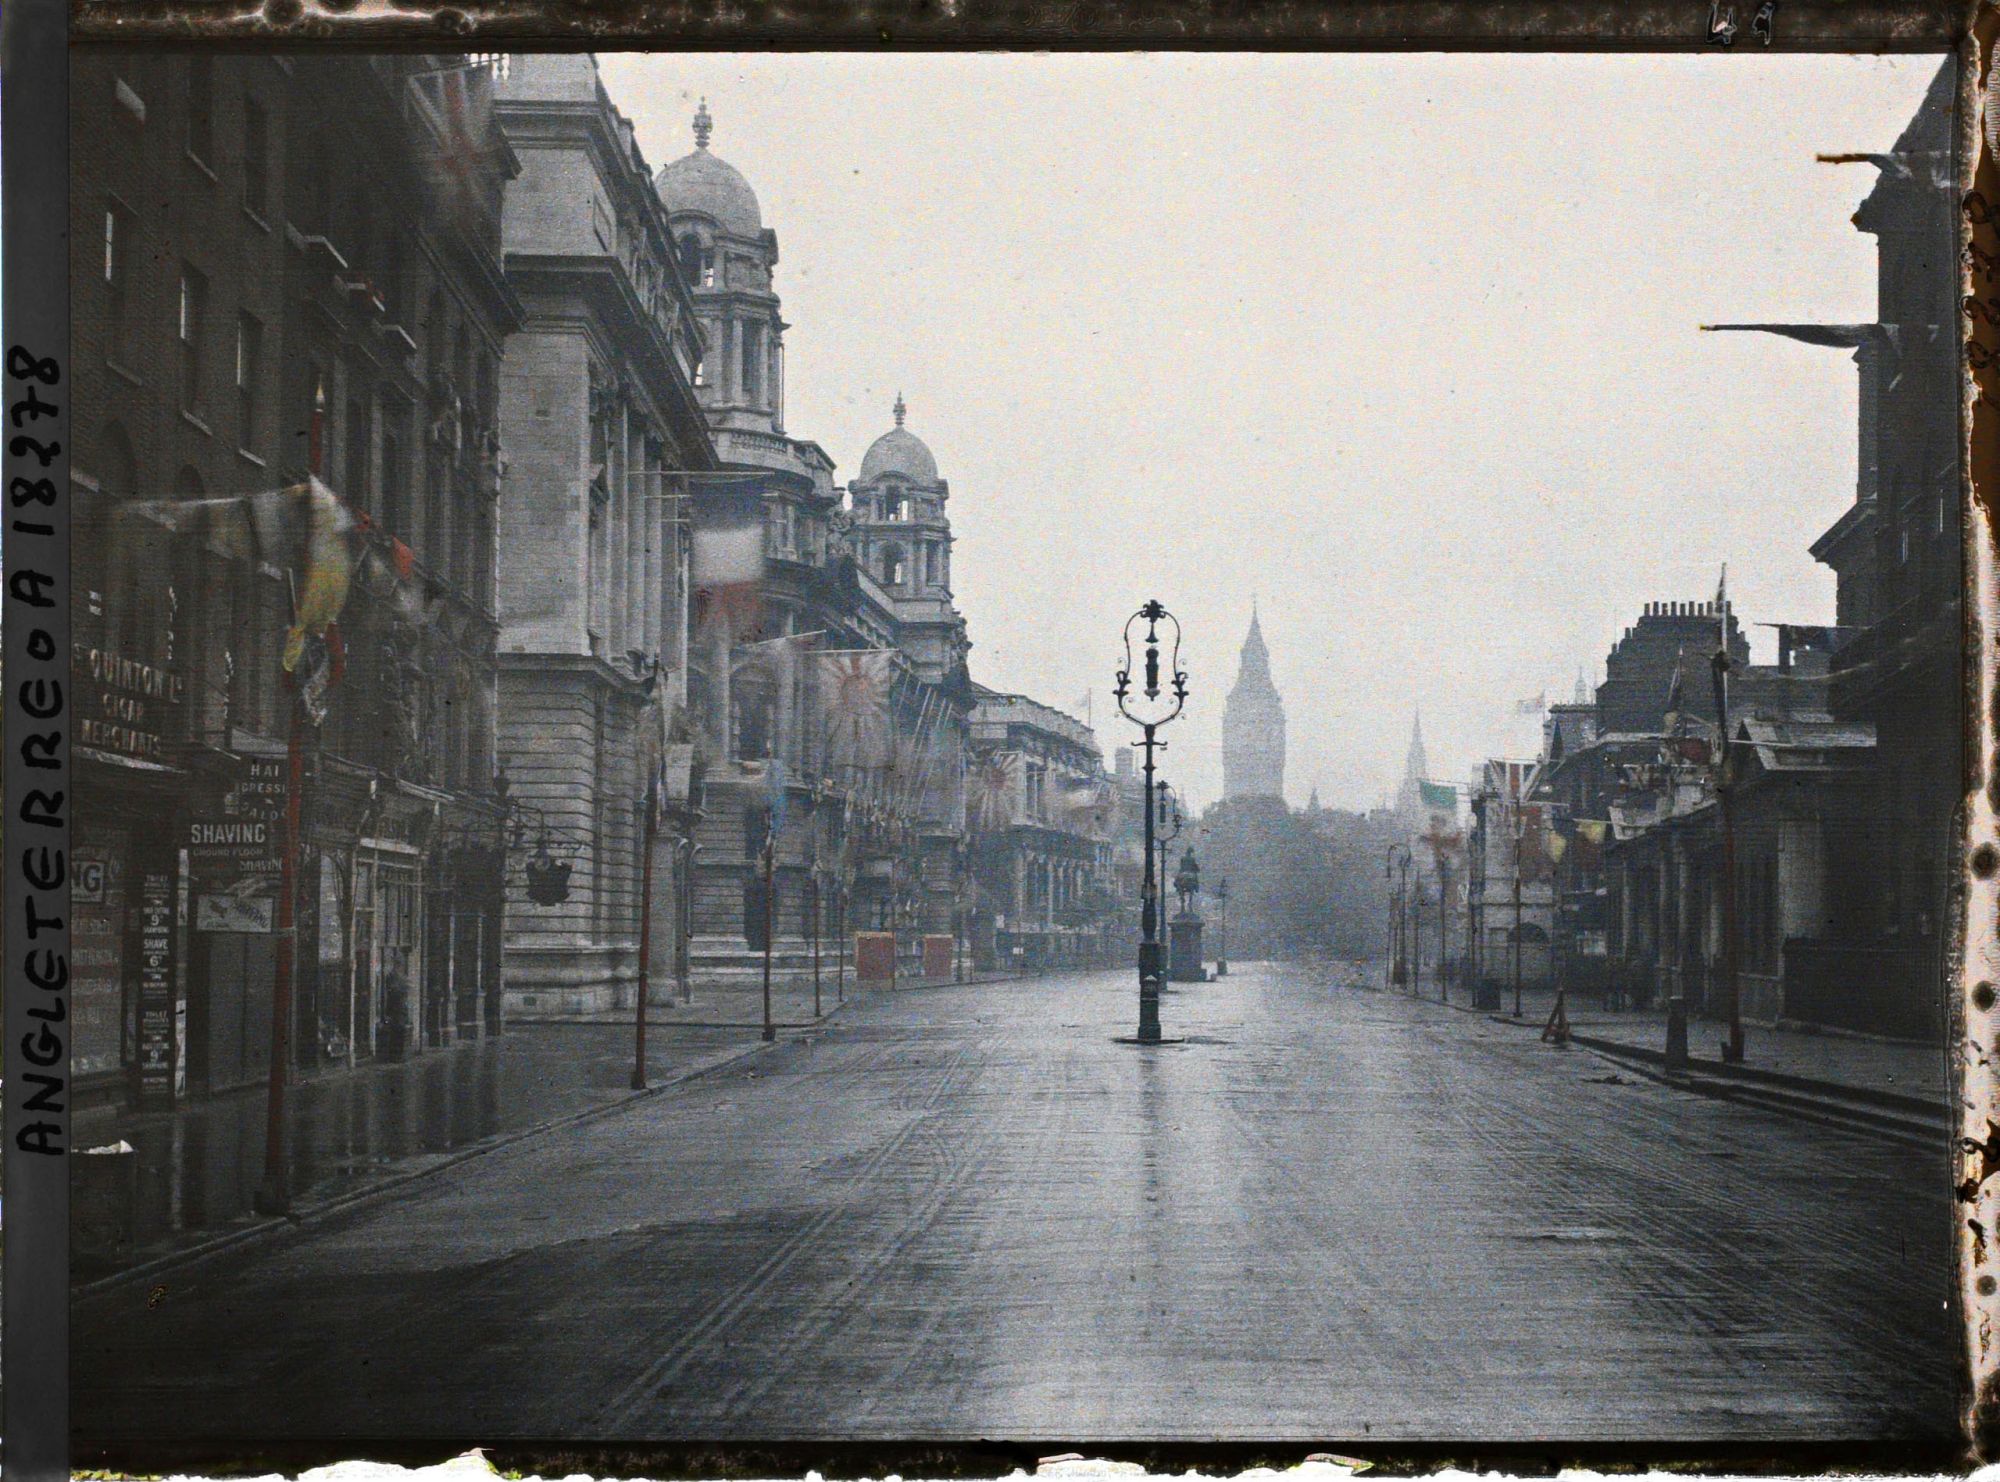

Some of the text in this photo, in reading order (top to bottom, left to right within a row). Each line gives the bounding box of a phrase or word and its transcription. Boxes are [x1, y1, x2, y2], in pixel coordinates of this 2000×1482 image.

[8, 344, 62, 536] 18278
[15, 680, 67, 1155] ANGLETERRE
[191, 823, 267, 844] SHAVING
